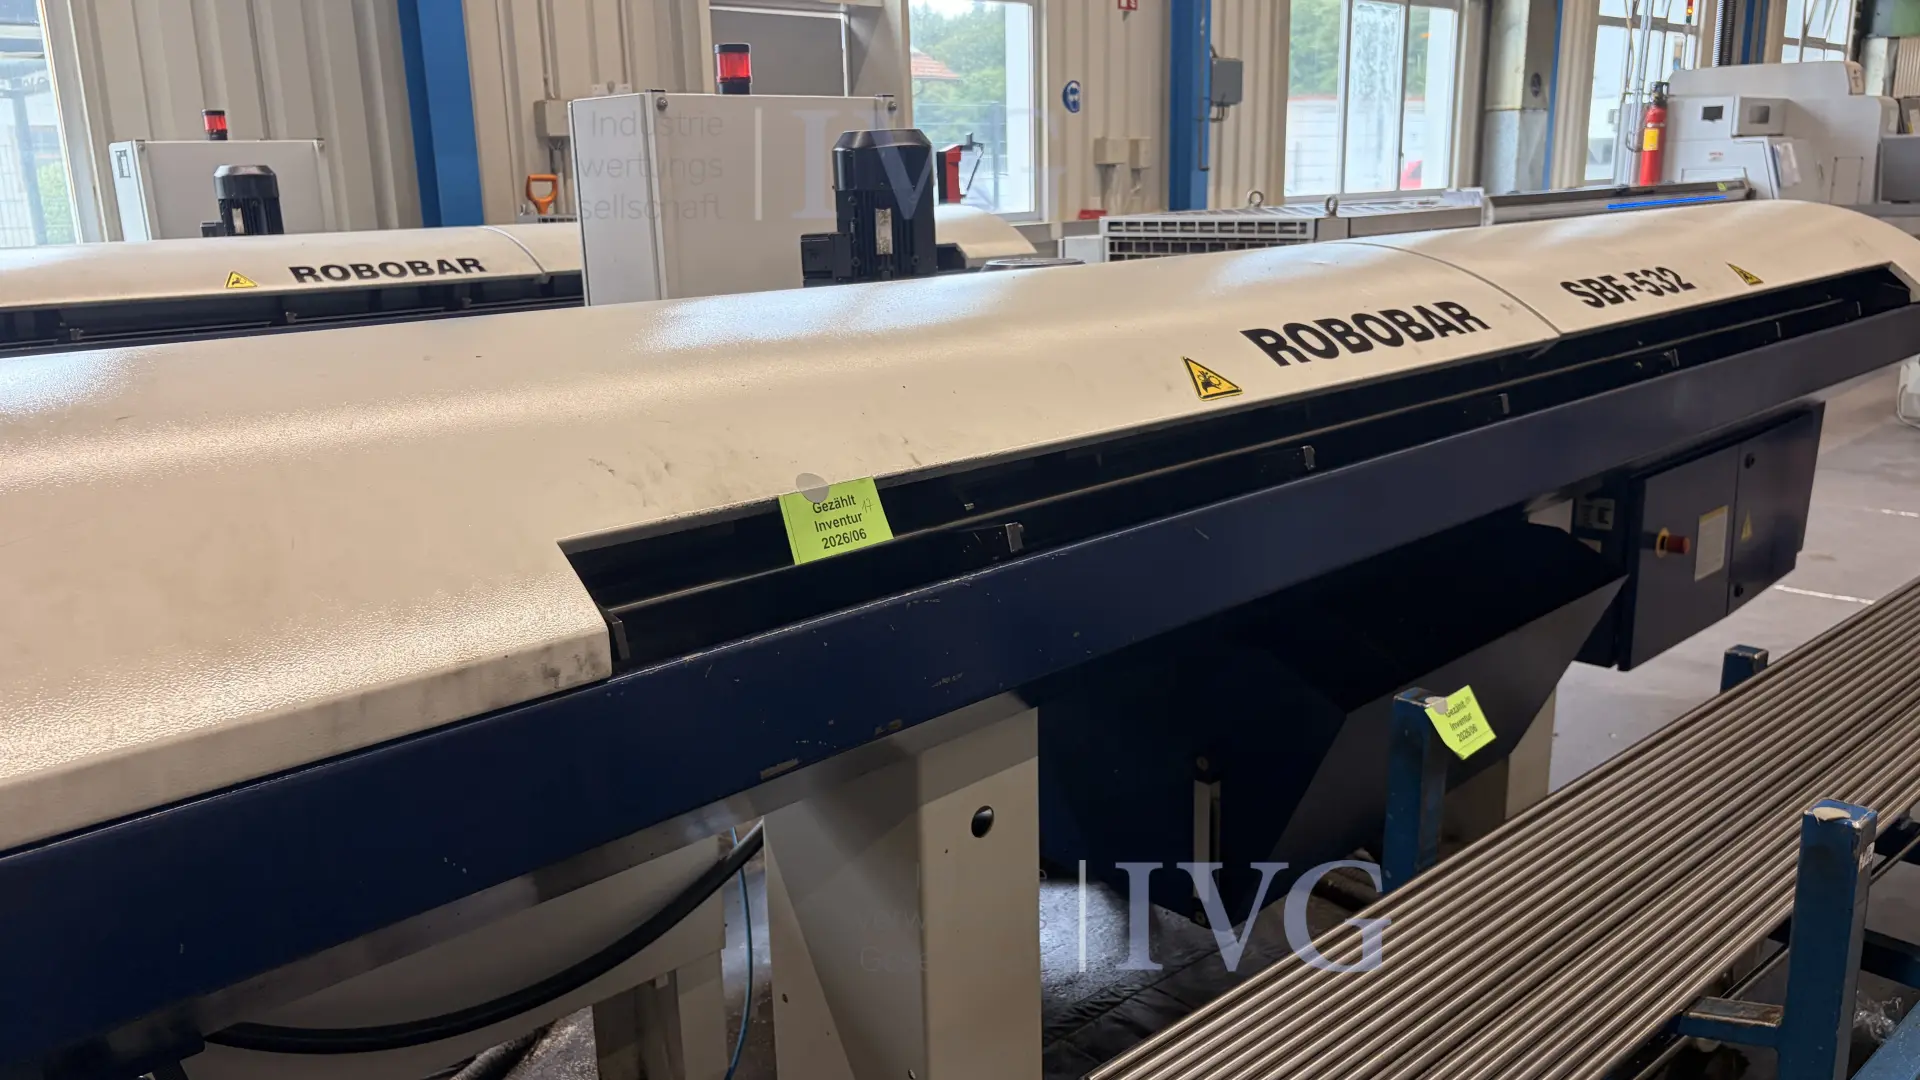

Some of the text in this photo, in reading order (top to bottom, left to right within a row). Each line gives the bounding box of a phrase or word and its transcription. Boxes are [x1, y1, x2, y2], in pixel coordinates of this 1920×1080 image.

[288, 257, 487, 284] ROBOBAR
[1560, 266, 1697, 308] SBF-532
[1240, 300, 1492, 367] ROBOBAR
[812, 494, 856, 514] Gezählt
[814, 512, 863, 532] Inventur
[821, 528, 867, 549] 2026/06
